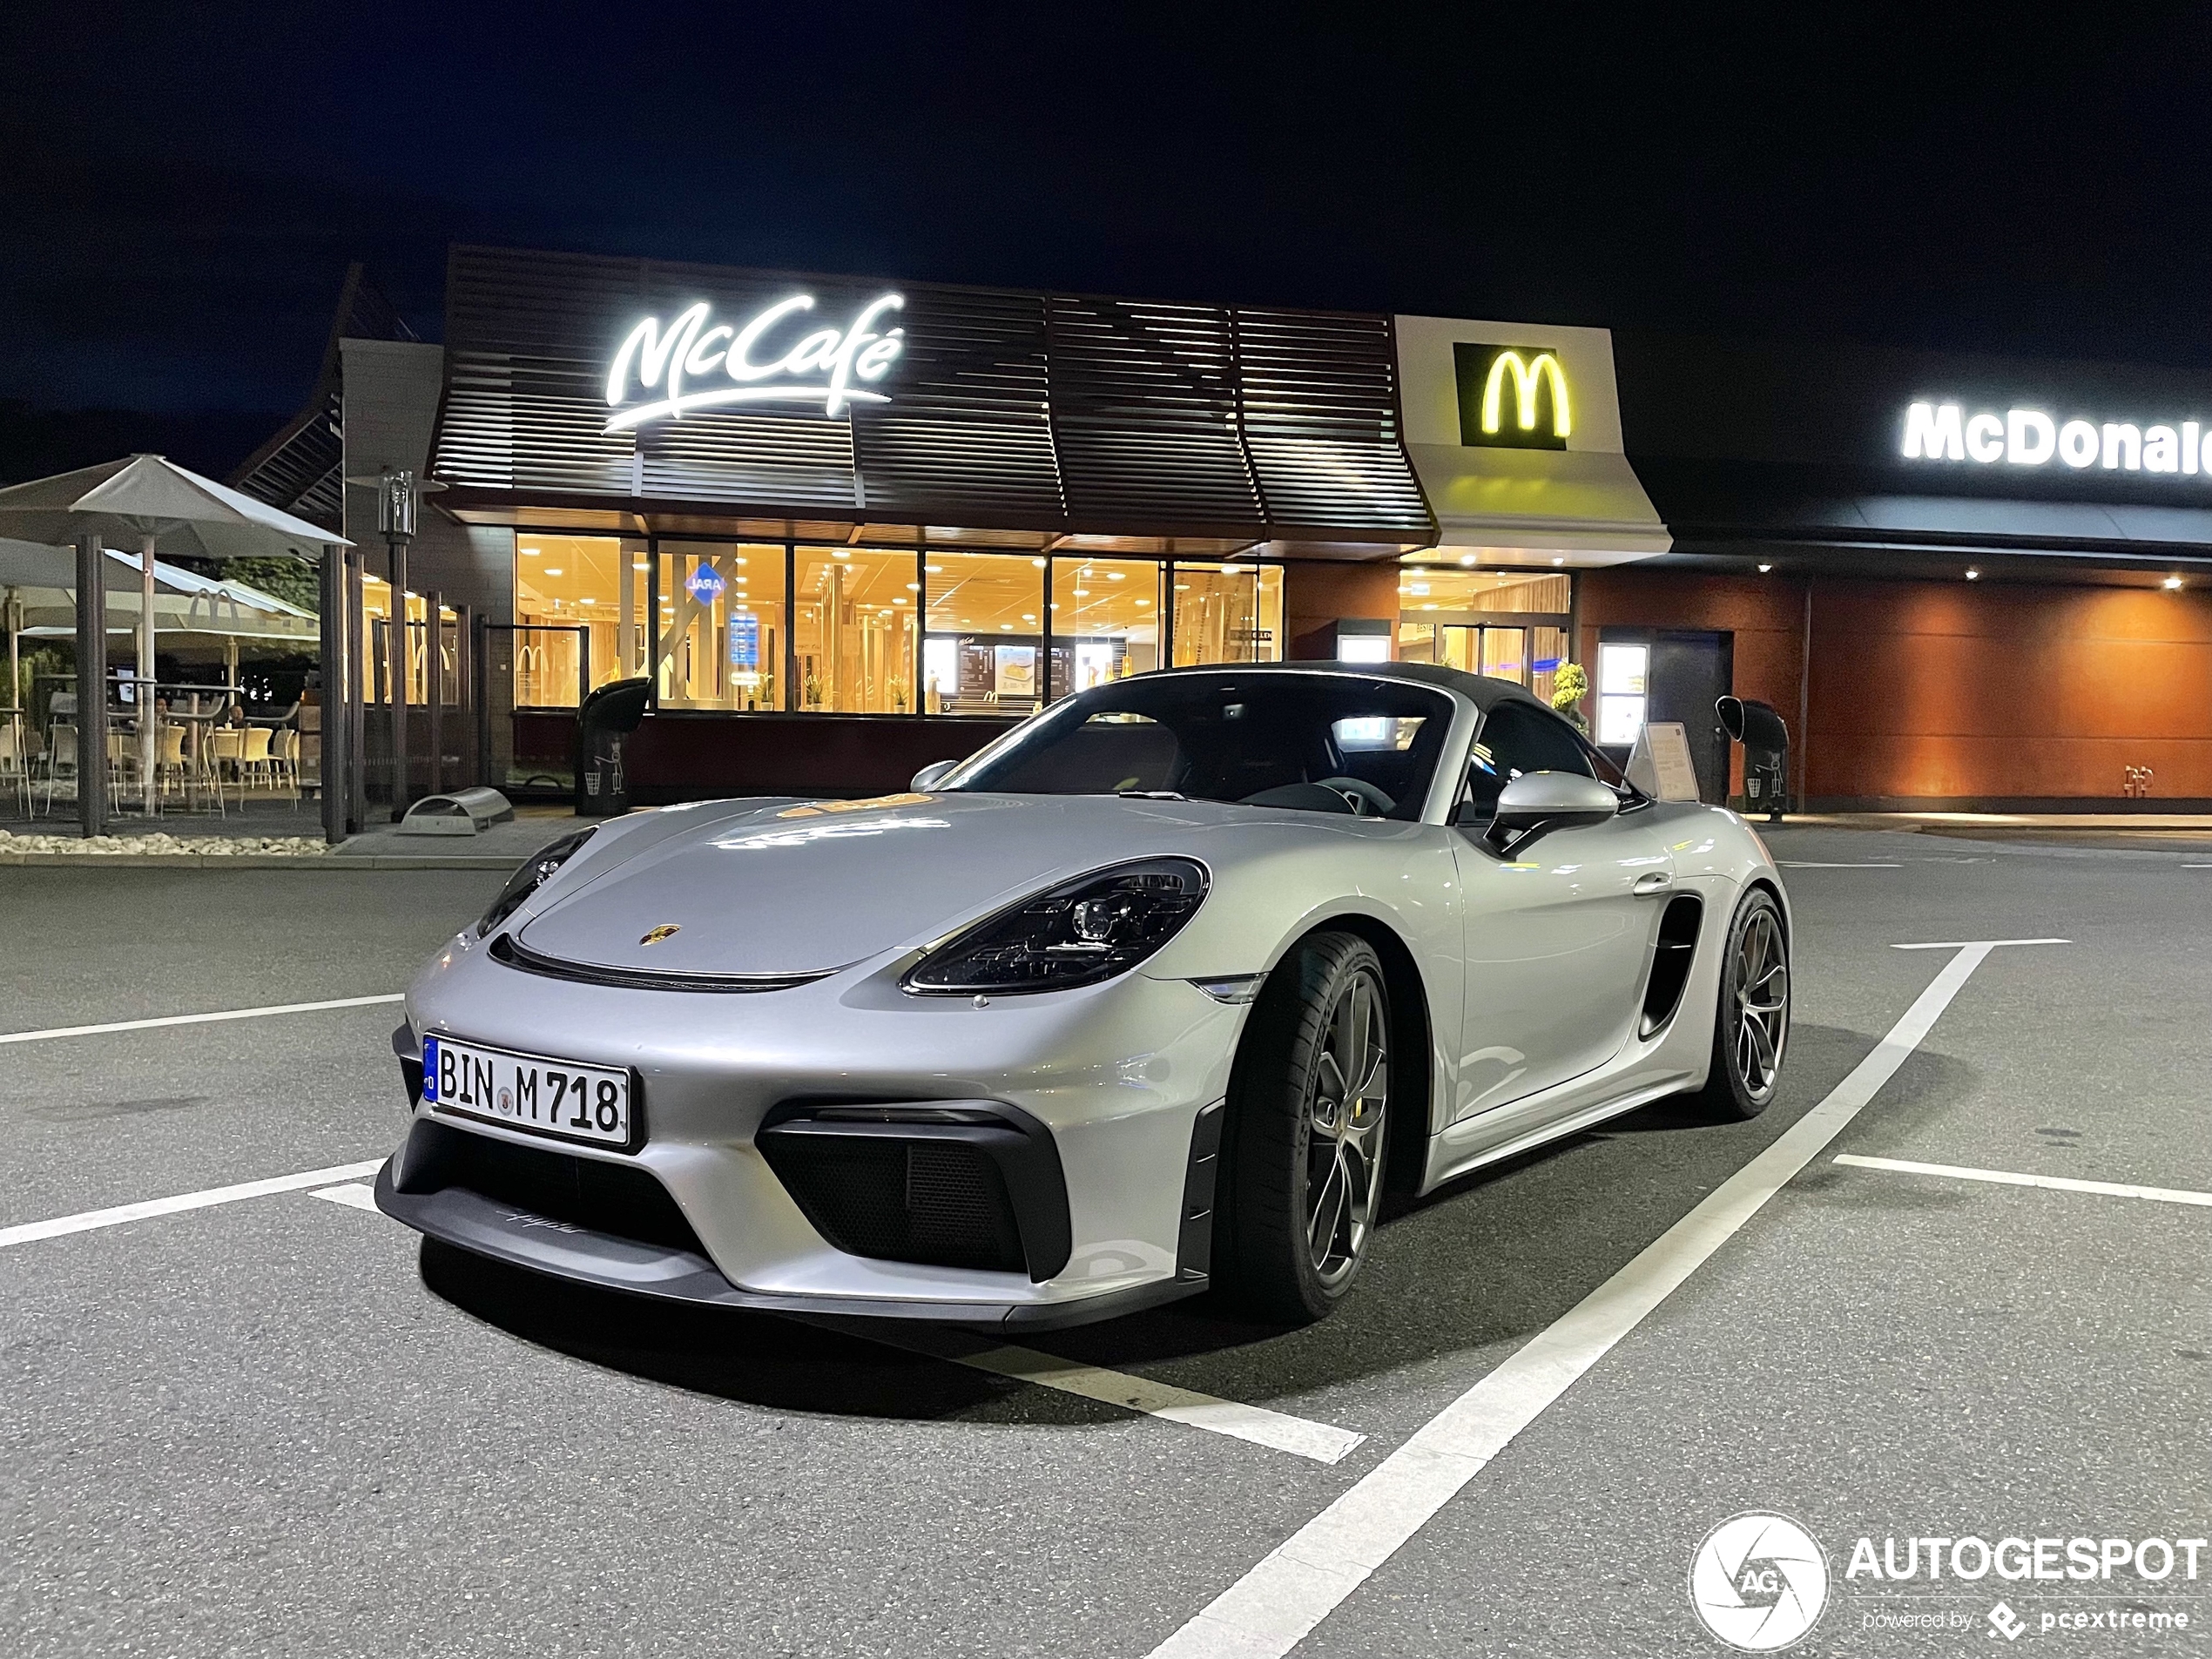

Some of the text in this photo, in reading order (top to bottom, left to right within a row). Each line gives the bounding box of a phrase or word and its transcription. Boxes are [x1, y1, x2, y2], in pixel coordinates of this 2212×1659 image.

[605, 293, 906, 421] McCafé
[1902, 401, 2212, 475] McDonal
[441, 1049, 494, 1110] BIN
